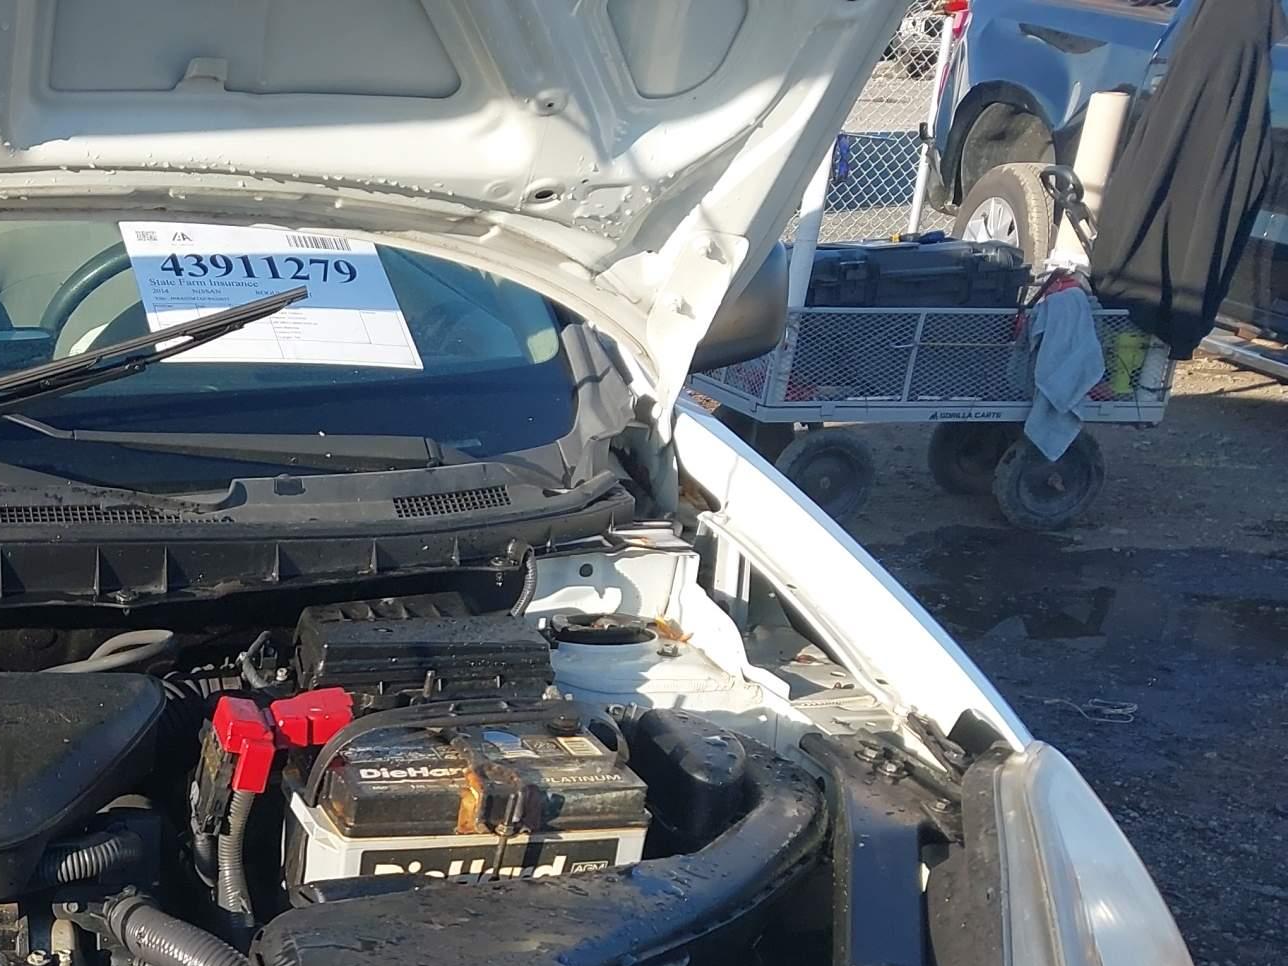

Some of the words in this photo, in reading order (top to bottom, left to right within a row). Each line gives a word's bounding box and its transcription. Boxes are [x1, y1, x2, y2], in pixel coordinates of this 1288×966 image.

[160, 252, 357, 284] 43911279
[148, 278, 176, 286] State
[179, 279, 208, 287] Farm
[209, 279, 260, 288] Insurance
